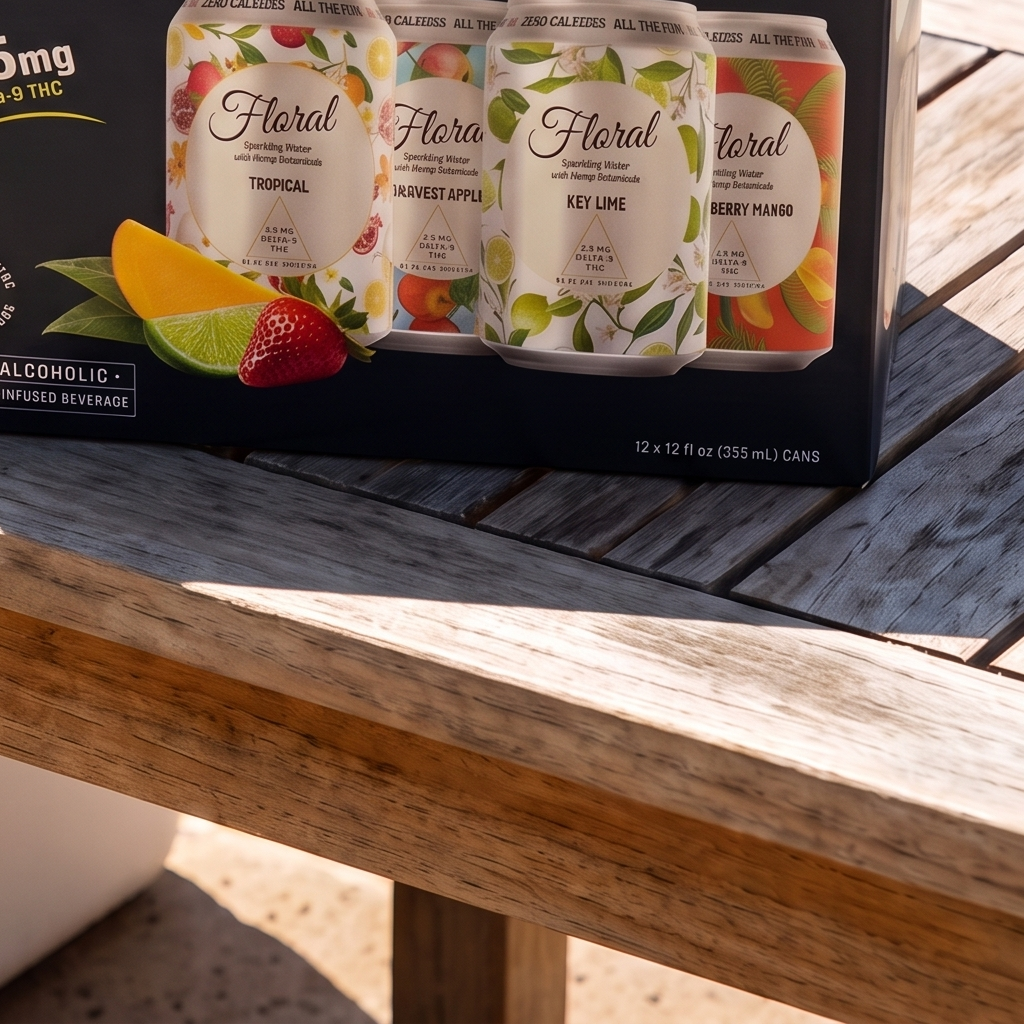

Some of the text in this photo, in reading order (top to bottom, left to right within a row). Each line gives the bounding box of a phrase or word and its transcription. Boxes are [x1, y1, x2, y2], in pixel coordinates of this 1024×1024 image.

[293, 0, 316, 13] ALL
[318, 1, 341, 15] THE
[453, 18, 474, 29] ALL
[476, 19, 497, 31] THE
[613, 18, 636, 31] ALL
[638, 20, 661, 33] THE
[749, 33, 771, 45] ALL
[773, 34, 794, 47] THE
[27, 80, 63, 99] THC
[208, 89, 340, 141] Floral
[394, 103, 483, 151] Flora
[528, 106, 661, 158] Floral
[714, 121, 791, 160] loral
[249, 176, 309, 193] TROPICAL
[567, 194, 626, 211] KEY LIME
[752, 203, 793, 217] MANGO
[586, 264, 605, 272] THC
[62, 393, 129, 408] BEVERAGE
[635, 440, 820, 463] 12 x 12 fl oz (355 mL) CANS
